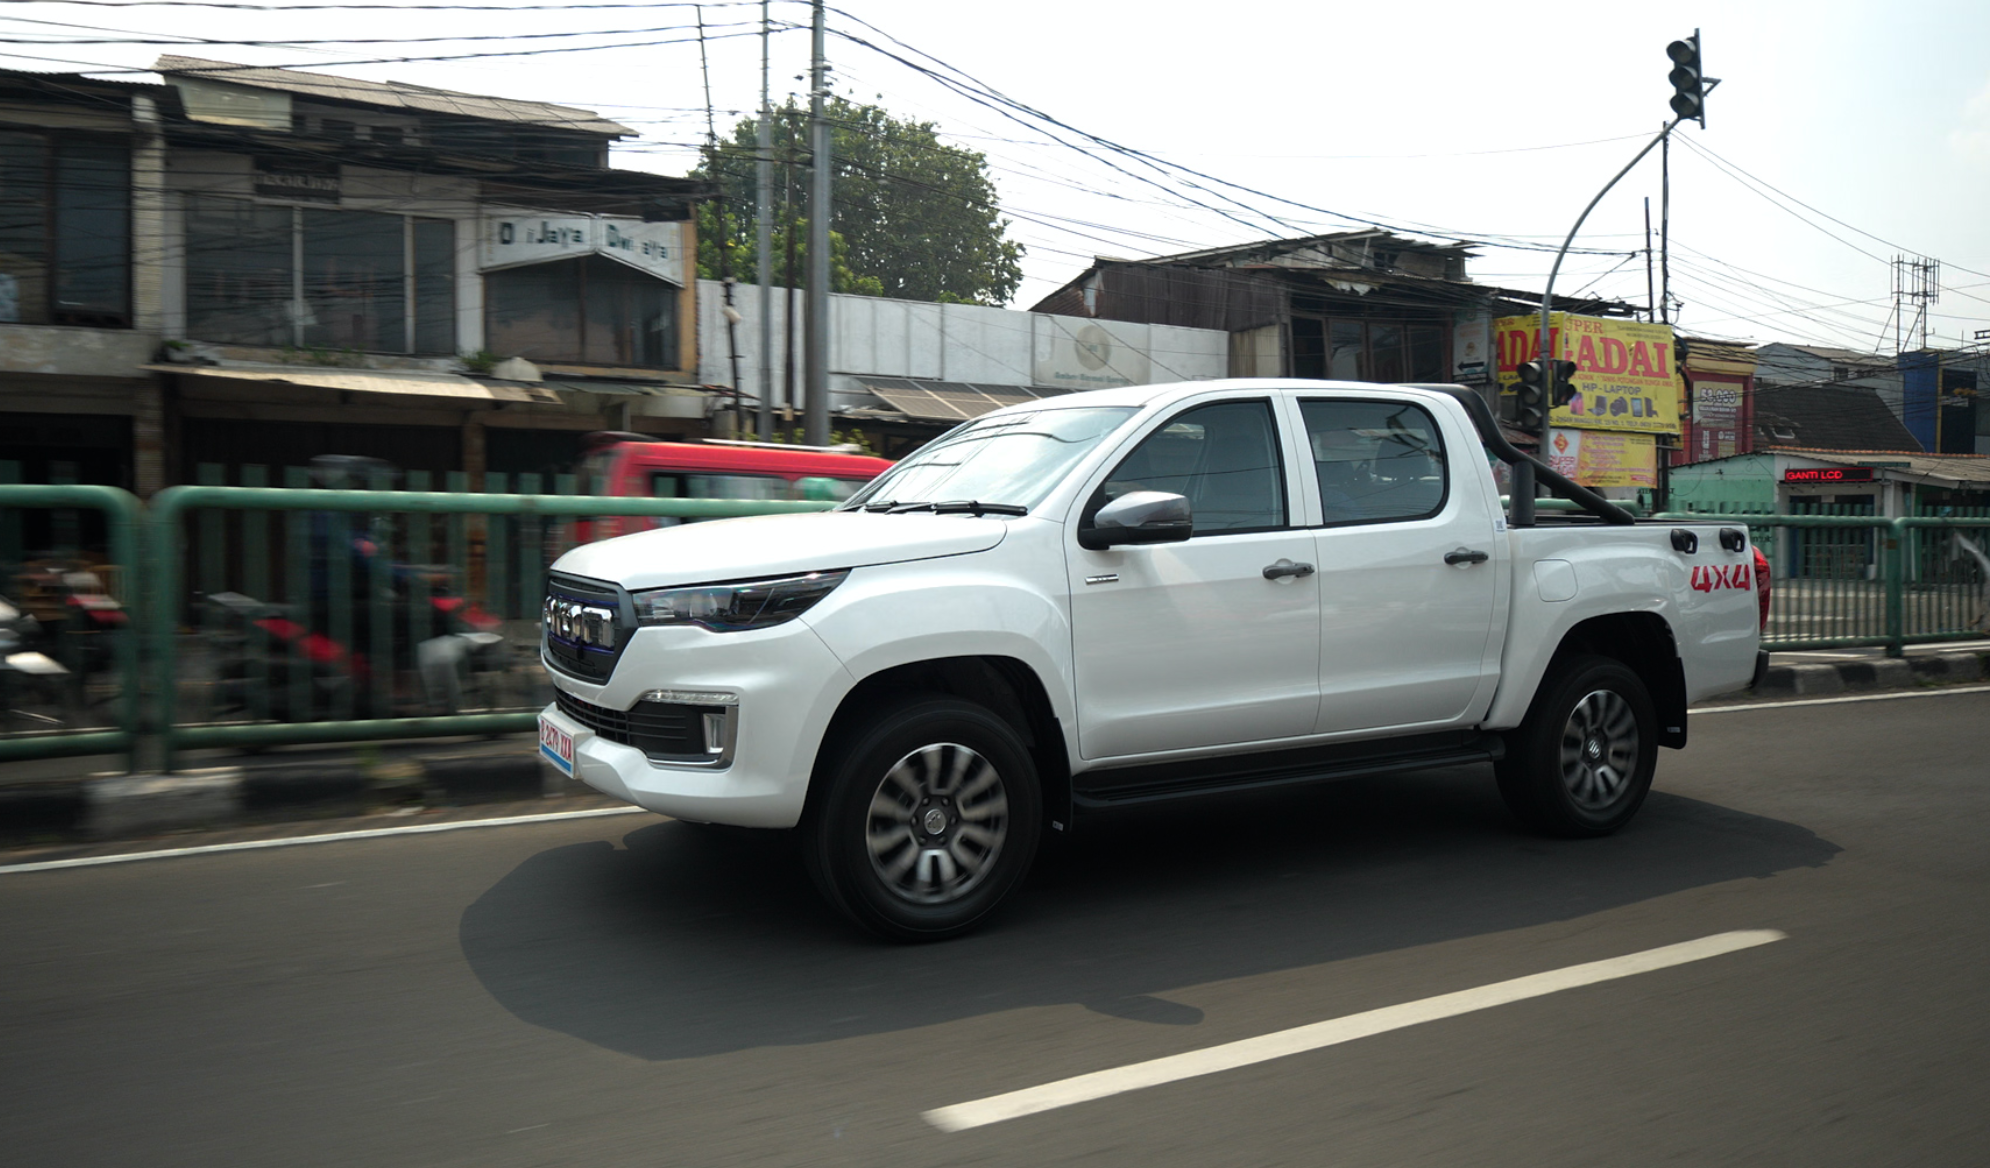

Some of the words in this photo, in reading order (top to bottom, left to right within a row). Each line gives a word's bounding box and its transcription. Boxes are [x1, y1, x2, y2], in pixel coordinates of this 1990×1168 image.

[537, 221, 584, 248] Jaya
[1565, 332, 1670, 379] ADAI
[1604, 384, 1641, 395] LAPTOP
[1786, 471, 1818, 480] GANTI
[1821, 470, 1843, 480] LCD
